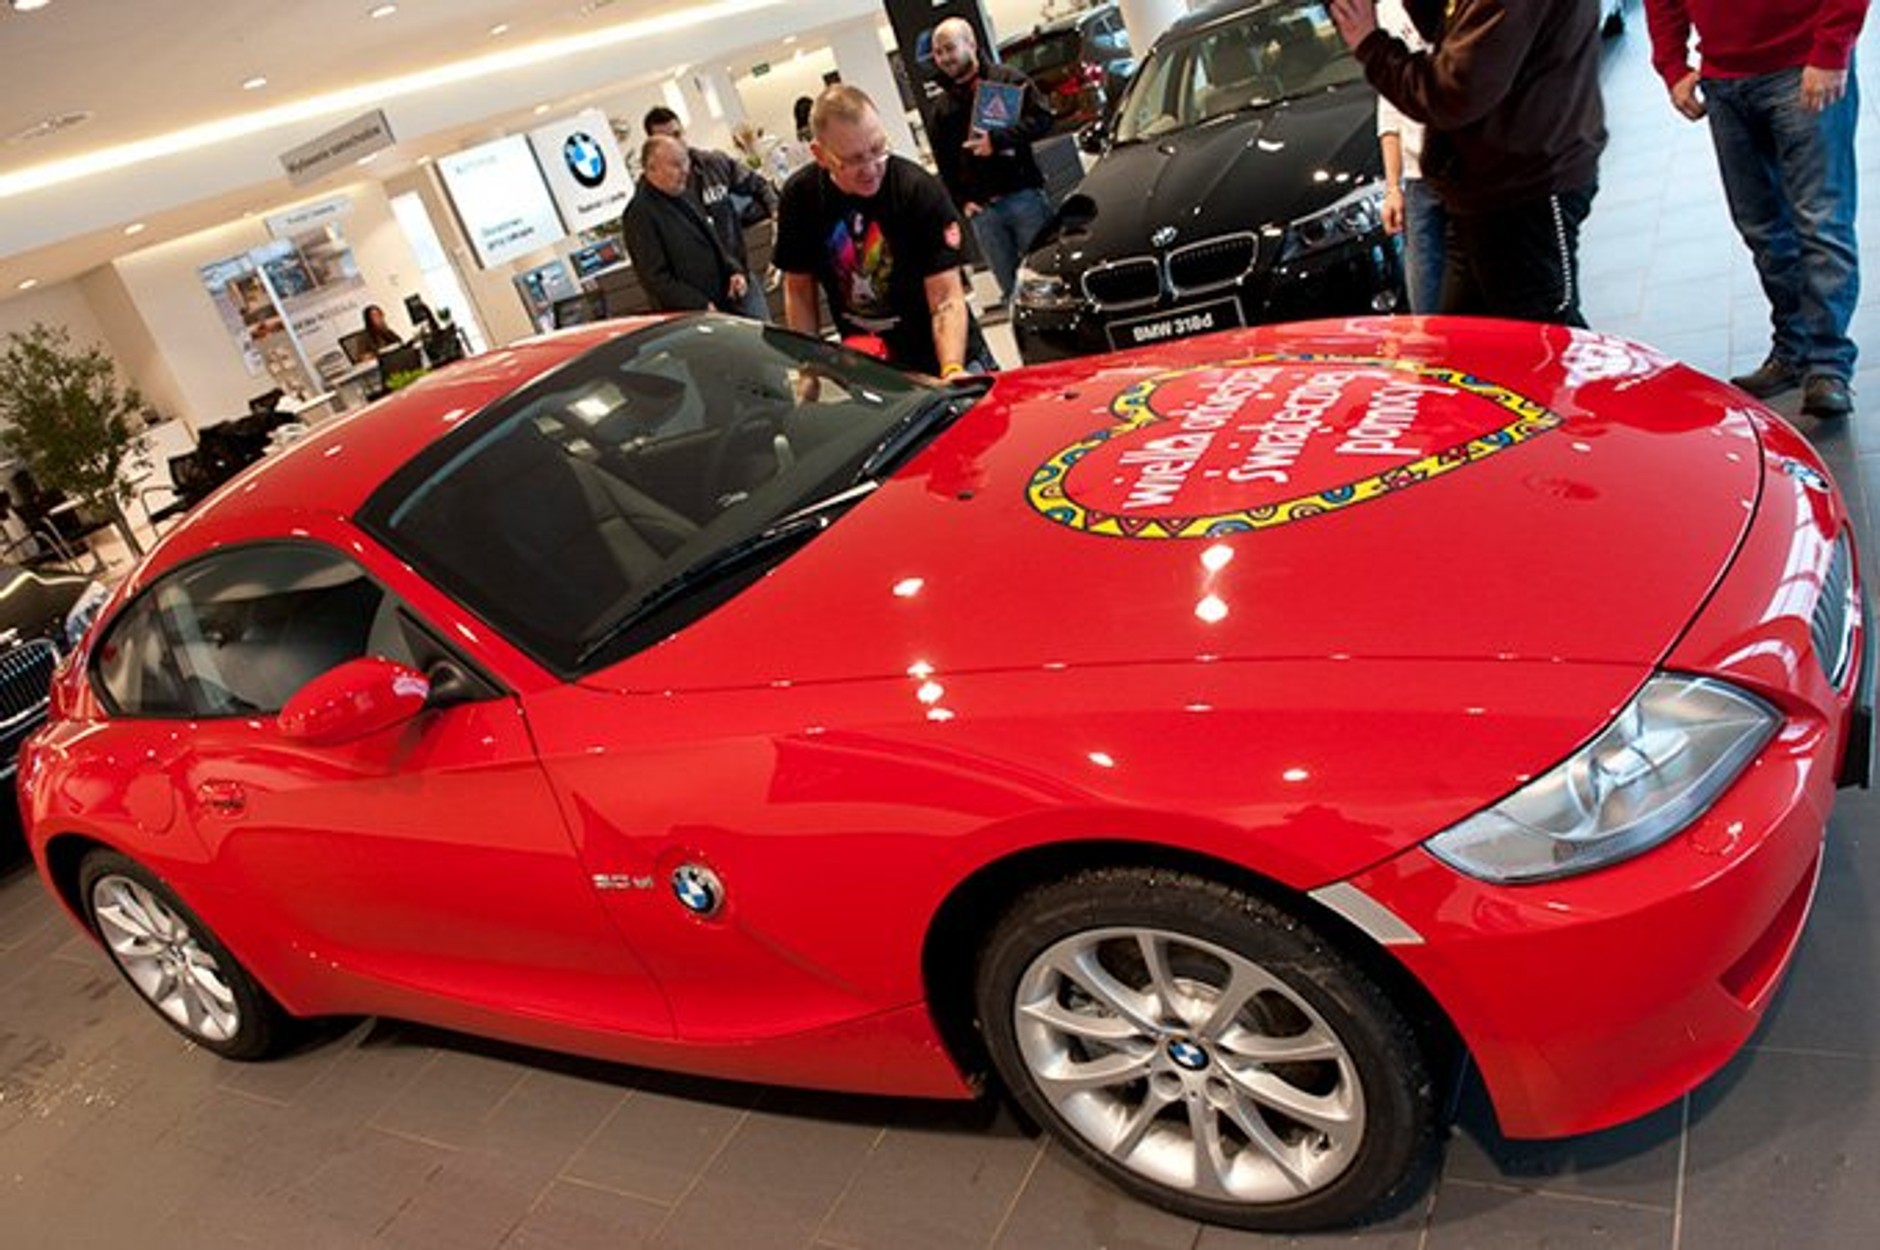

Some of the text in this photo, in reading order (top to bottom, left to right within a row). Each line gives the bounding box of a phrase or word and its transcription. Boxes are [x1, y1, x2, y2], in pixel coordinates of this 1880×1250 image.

[1133, 321, 1172, 342] BMW
[1334, 381, 1460, 456] pomocy
[1113, 430, 1216, 509] wielka
